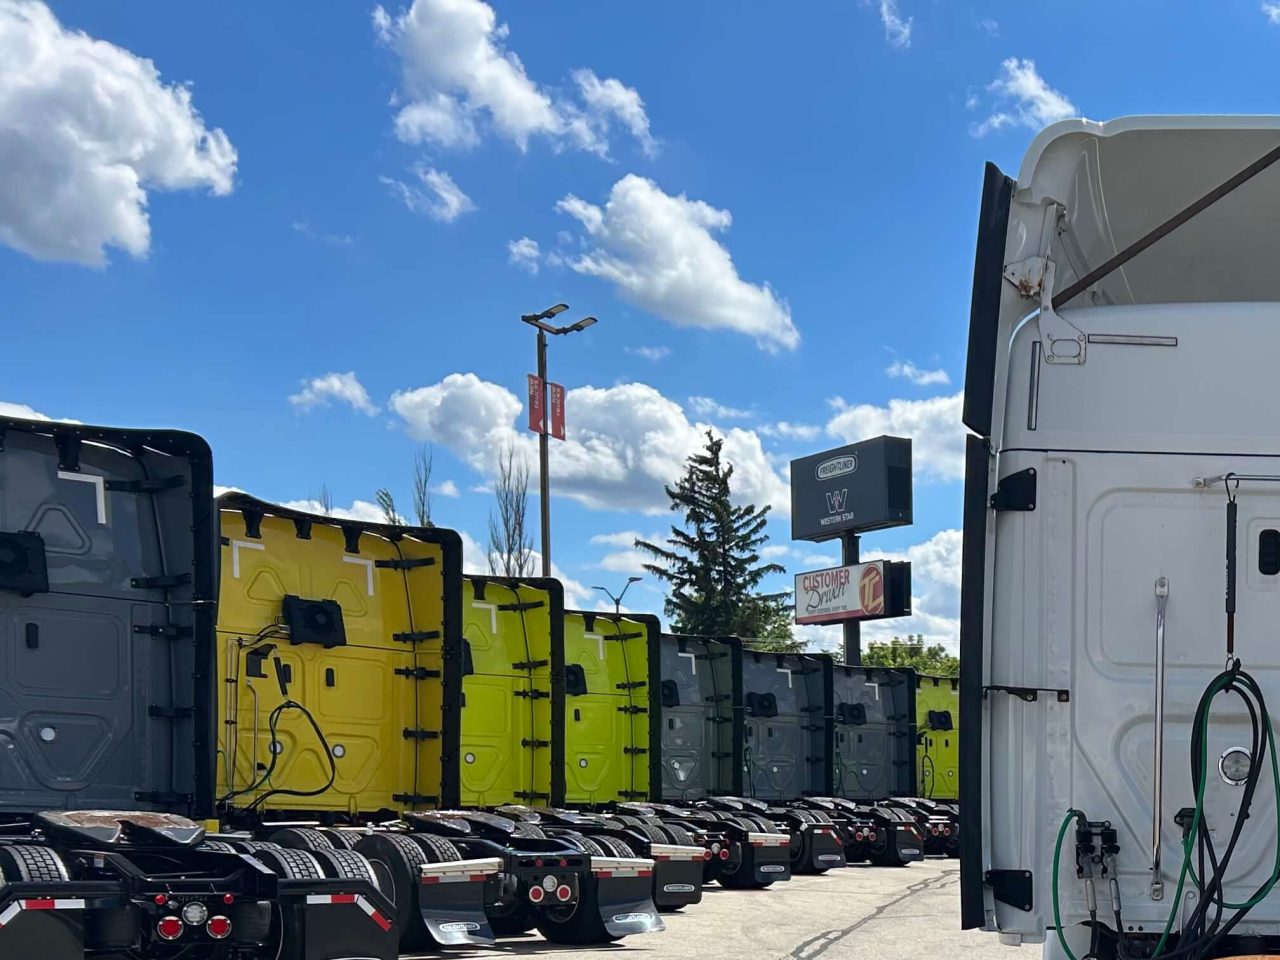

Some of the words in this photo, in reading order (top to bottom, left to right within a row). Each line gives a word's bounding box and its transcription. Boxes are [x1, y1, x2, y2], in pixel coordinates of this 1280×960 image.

[819, 459, 854, 475] FREIGHTLINER
[820, 515, 842, 526] WESTERN
[842, 512, 854, 522] STAR
[803, 568, 850, 592] CUSTOMER
[805, 583, 846, 613] Driven
